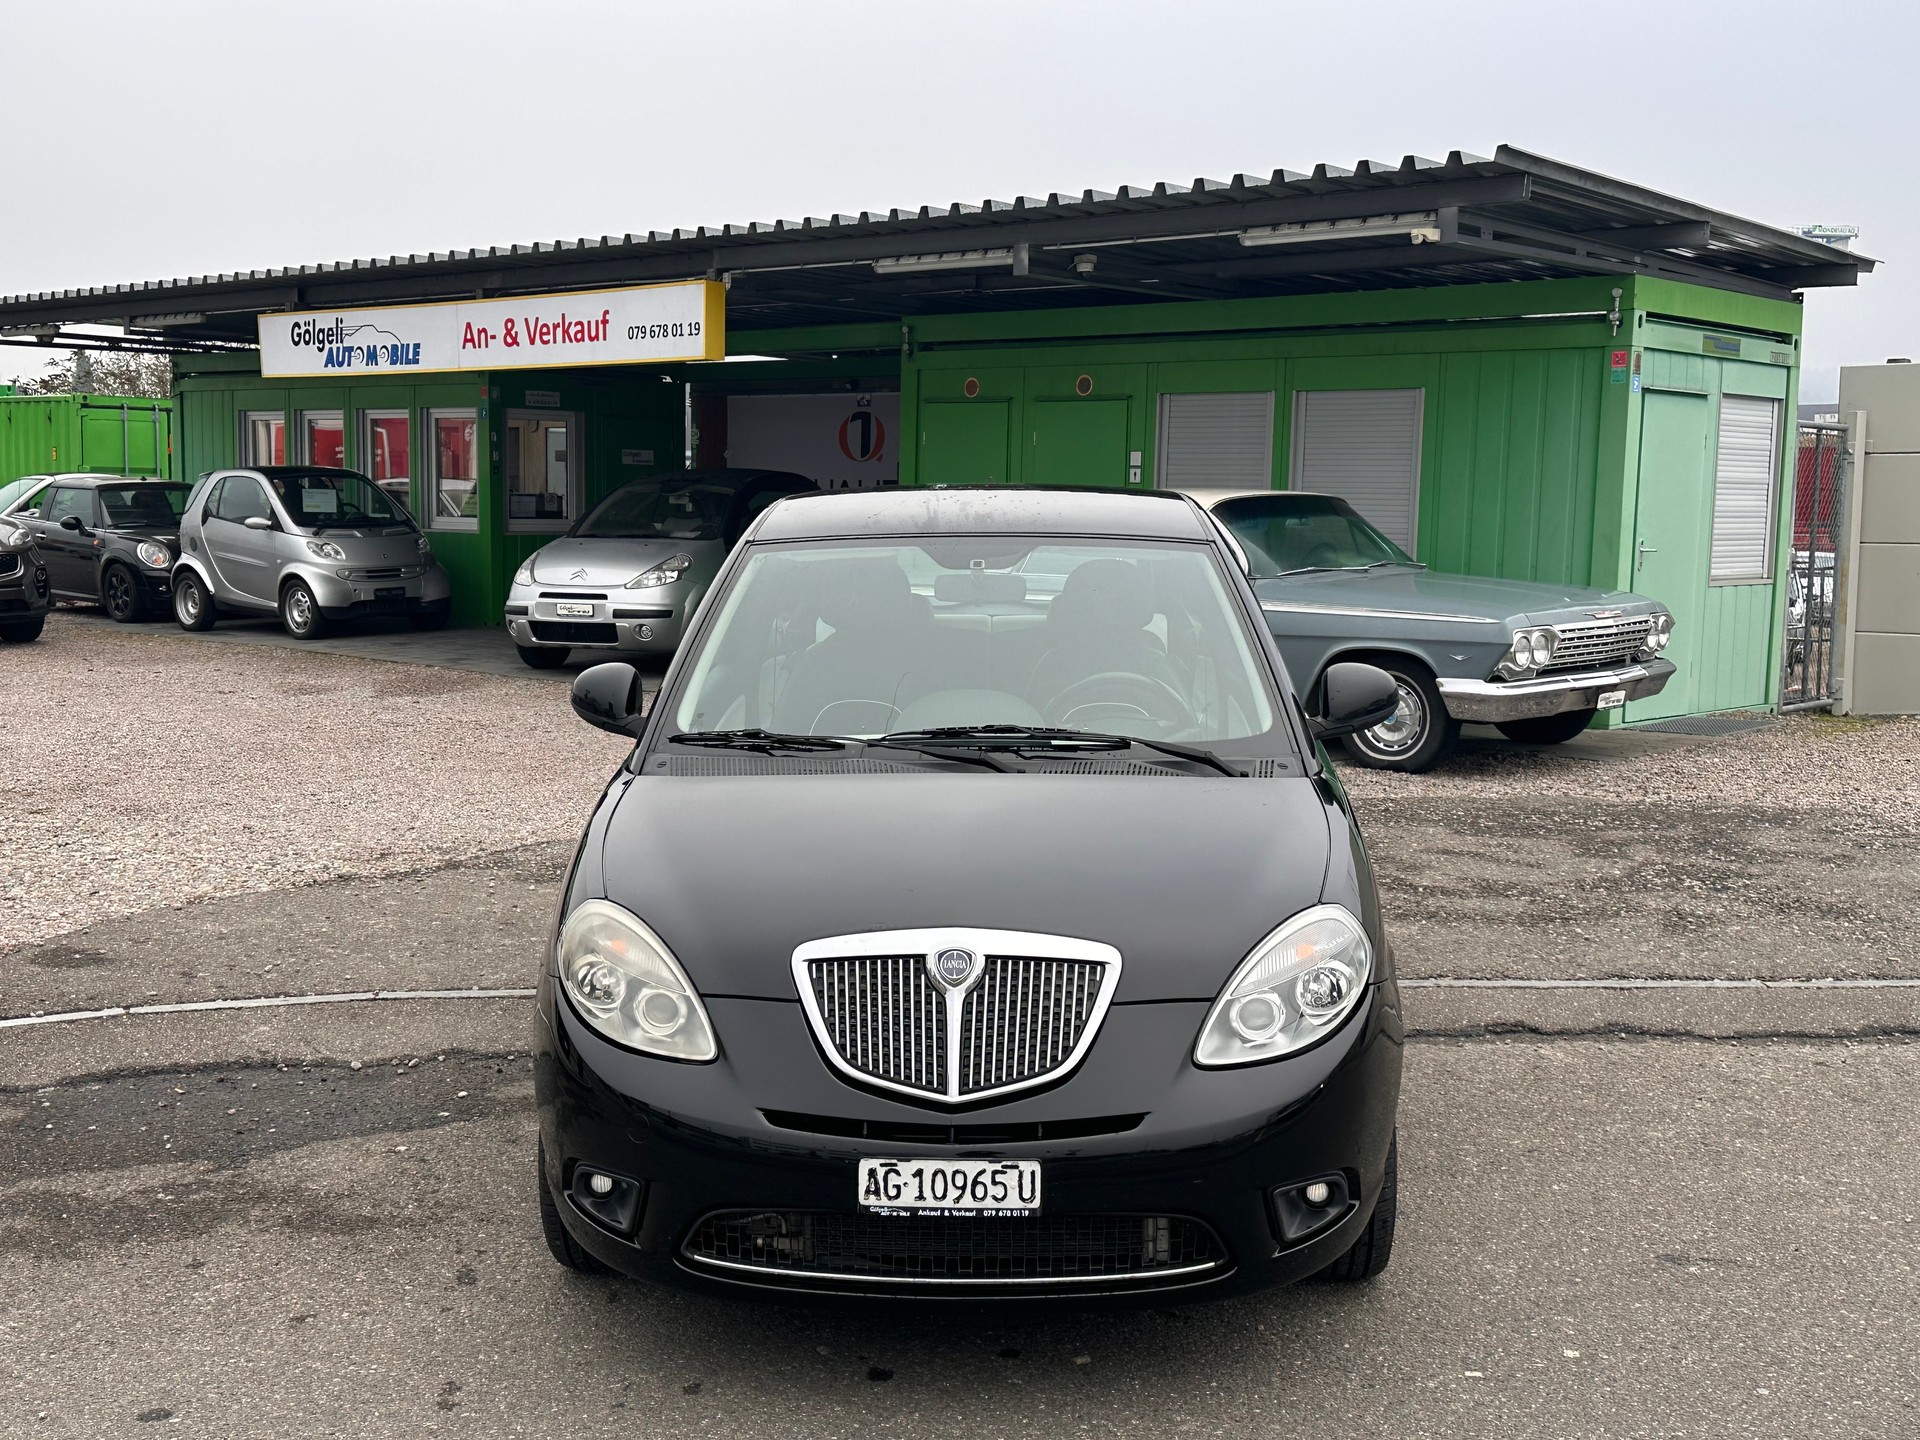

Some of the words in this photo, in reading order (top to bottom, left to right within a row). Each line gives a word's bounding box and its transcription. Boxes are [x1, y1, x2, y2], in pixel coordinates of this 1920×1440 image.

[290, 317, 343, 353] Gölgeli
[462, 321, 497, 350] An-
[503, 318, 520, 348] &
[524, 309, 610, 346] Verkauf
[627, 325, 647, 340] 079
[649, 323, 669, 339] 678
[671, 322, 685, 338] 01
[687, 321, 701, 336] 19
[943, 959, 967, 969] LANCIA
[983, 1209, 996, 1217] 079
